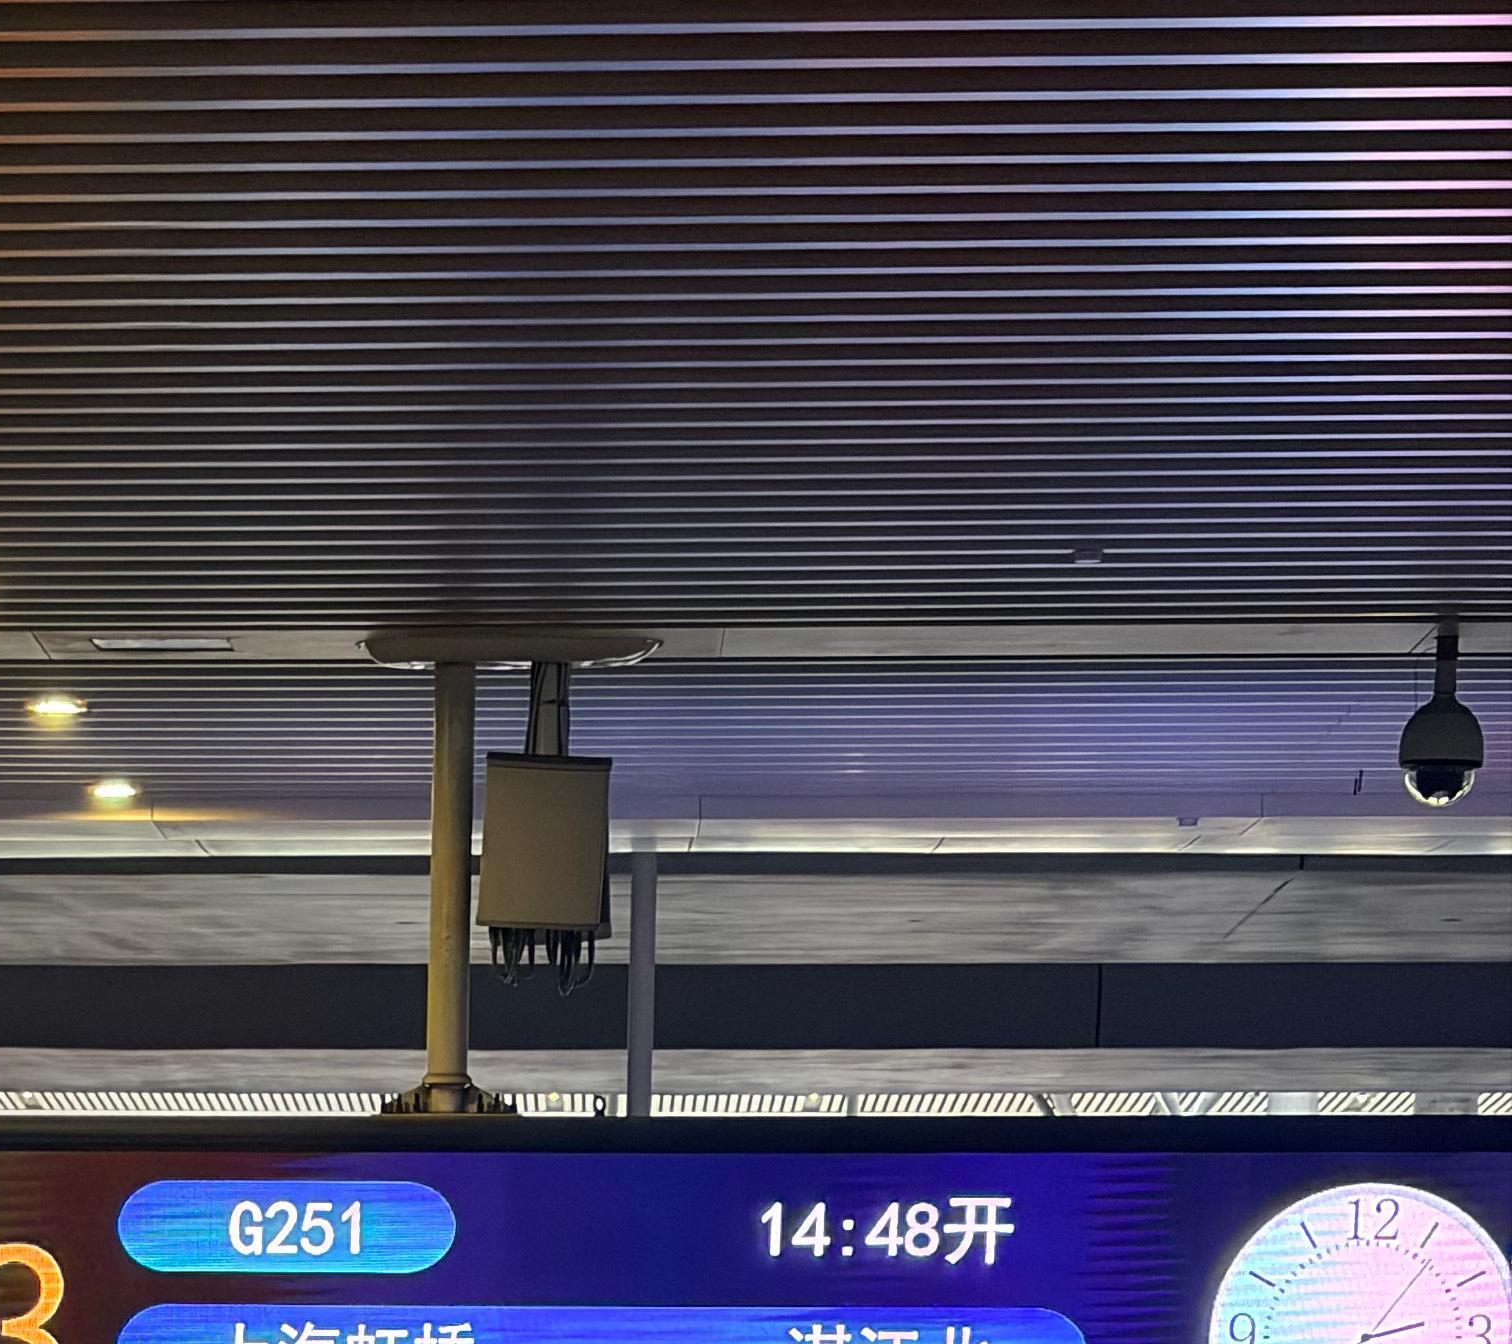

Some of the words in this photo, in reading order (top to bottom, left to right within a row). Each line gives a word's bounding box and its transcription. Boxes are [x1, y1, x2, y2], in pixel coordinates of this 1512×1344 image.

[228, 1200, 363, 1256] G251
[760, 1196, 1016, 1266] 14:48开
[1347, 1198, 1401, 1241] 12
